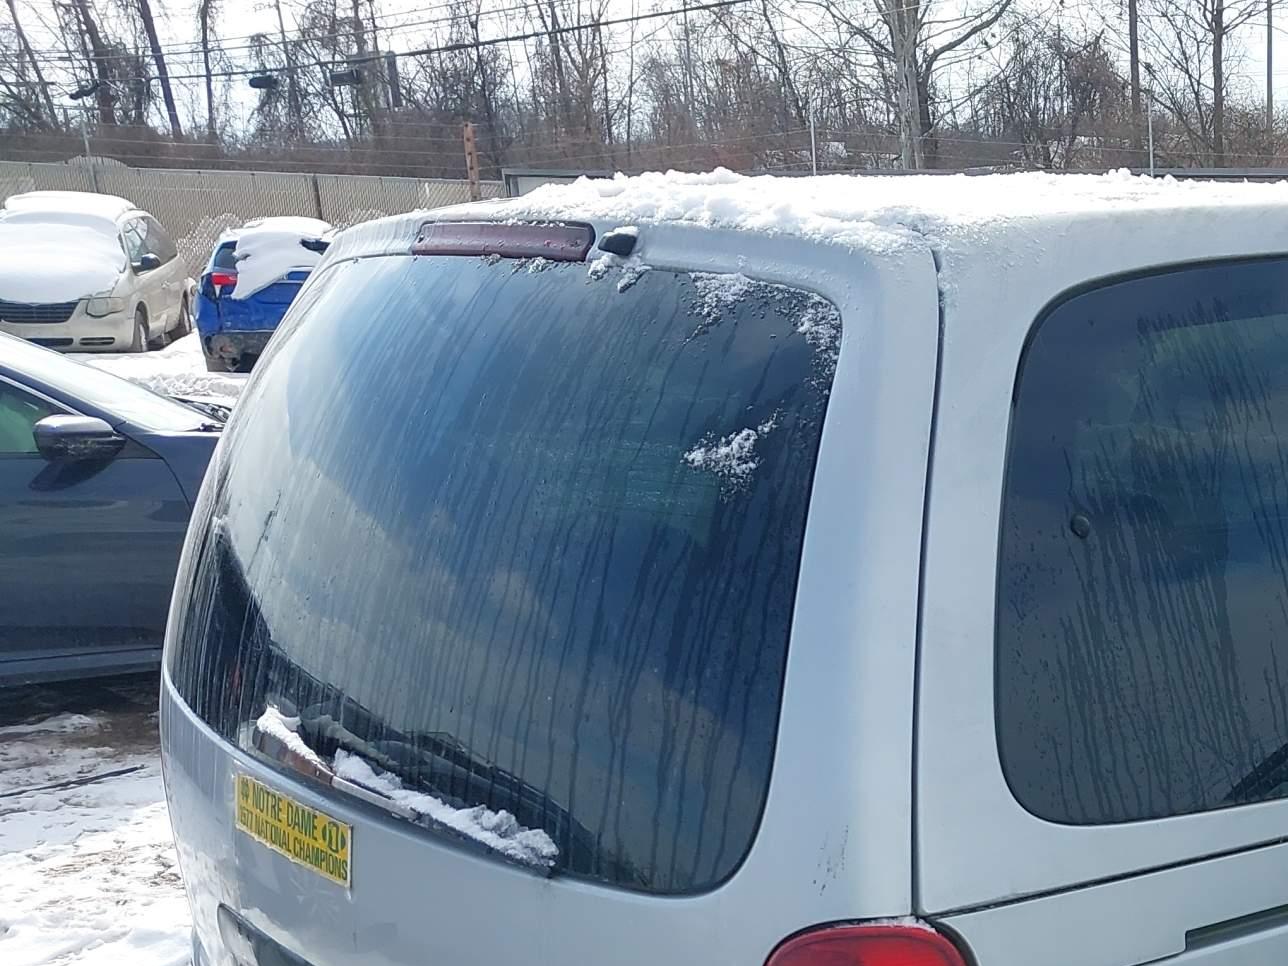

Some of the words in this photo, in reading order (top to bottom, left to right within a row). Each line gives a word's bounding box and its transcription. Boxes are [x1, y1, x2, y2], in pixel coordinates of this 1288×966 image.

[252, 783, 282, 822] NOTRE
[287, 804, 318, 841] DAME
[255, 813, 294, 854] NATIONAL
[294, 837, 348, 881] CHAMPIONS
